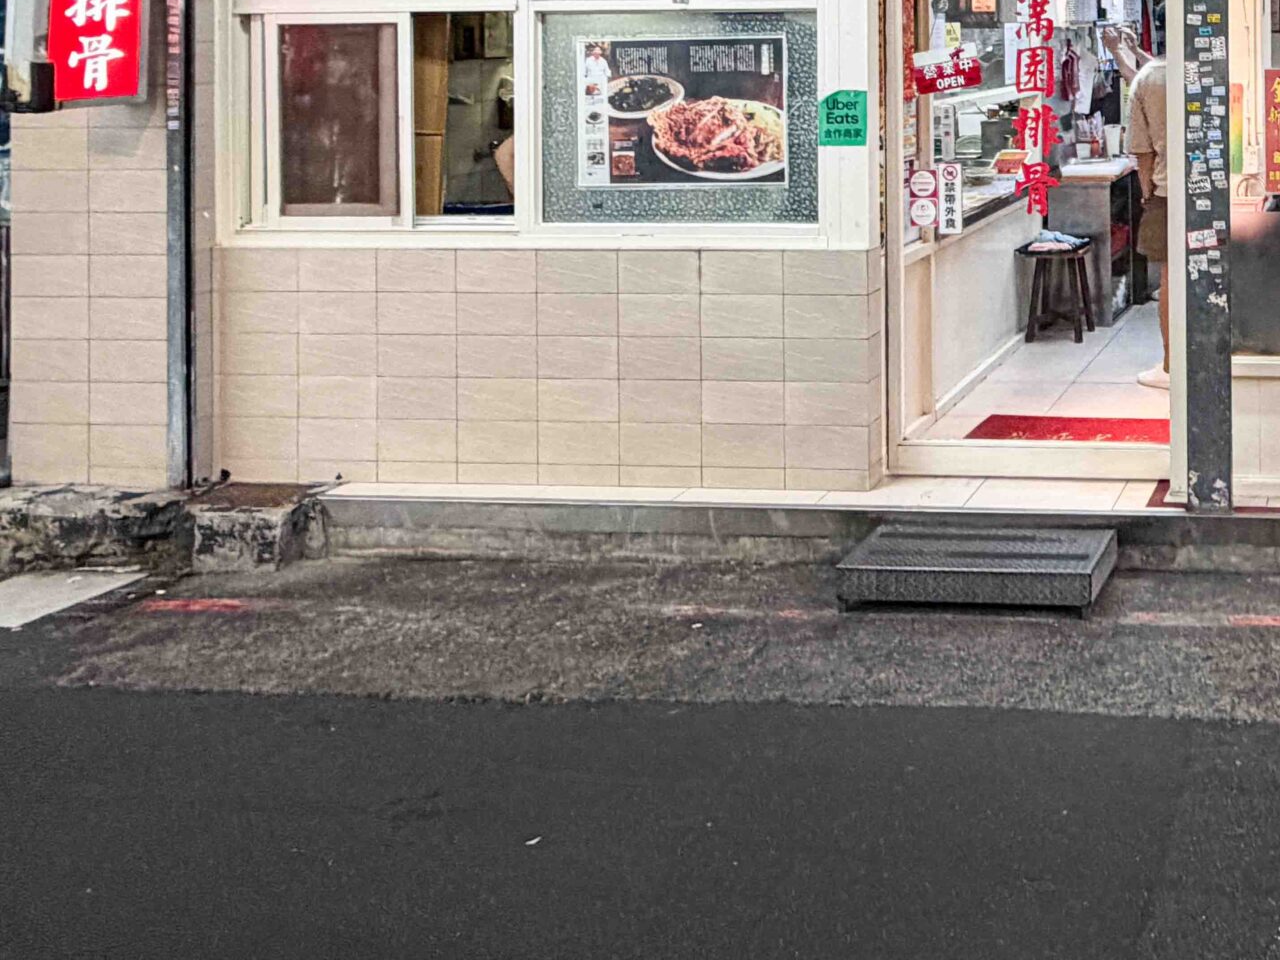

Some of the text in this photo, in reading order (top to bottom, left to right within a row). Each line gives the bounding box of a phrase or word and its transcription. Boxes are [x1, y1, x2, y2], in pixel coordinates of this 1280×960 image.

[936, 74, 966, 90] OPEN
[826, 97, 860, 111] Uber
[826, 111, 860, 125] Eats
